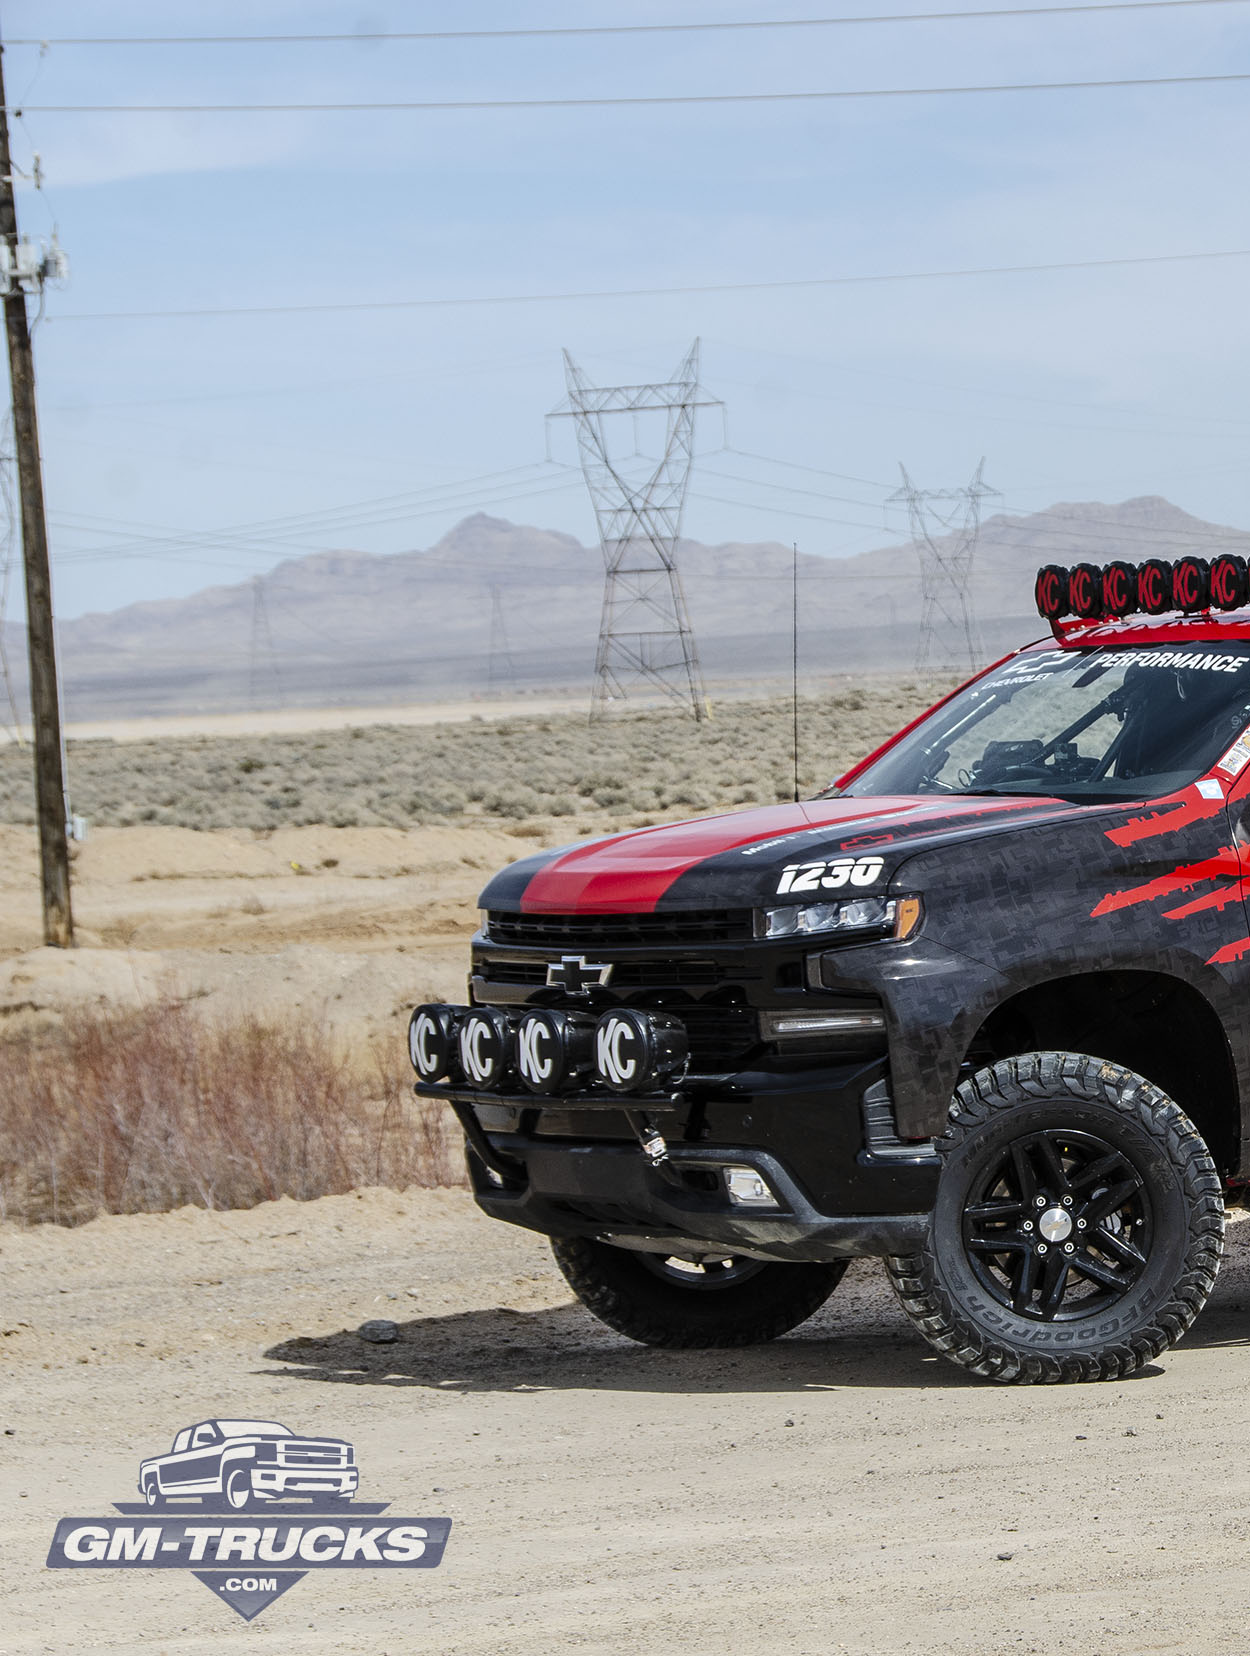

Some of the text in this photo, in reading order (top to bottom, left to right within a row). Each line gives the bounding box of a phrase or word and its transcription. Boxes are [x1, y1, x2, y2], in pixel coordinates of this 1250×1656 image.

[1038, 569, 1059, 611] KC
[1069, 567, 1091, 611] KC
[1103, 566, 1126, 608] KC
[1138, 564, 1161, 606] KC
[1173, 562, 1198, 605] KC
[1211, 559, 1236, 604] KC
[981, 672, 1054, 690] CHEVROLET
[1089, 651, 1250, 673] PERFORMANCE
[776, 856, 884, 895] 1230
[410, 1013, 437, 1076] KC
[459, 1018, 492, 1082] KC
[519, 1018, 551, 1084] KC
[597, 1018, 636, 1084] KC
